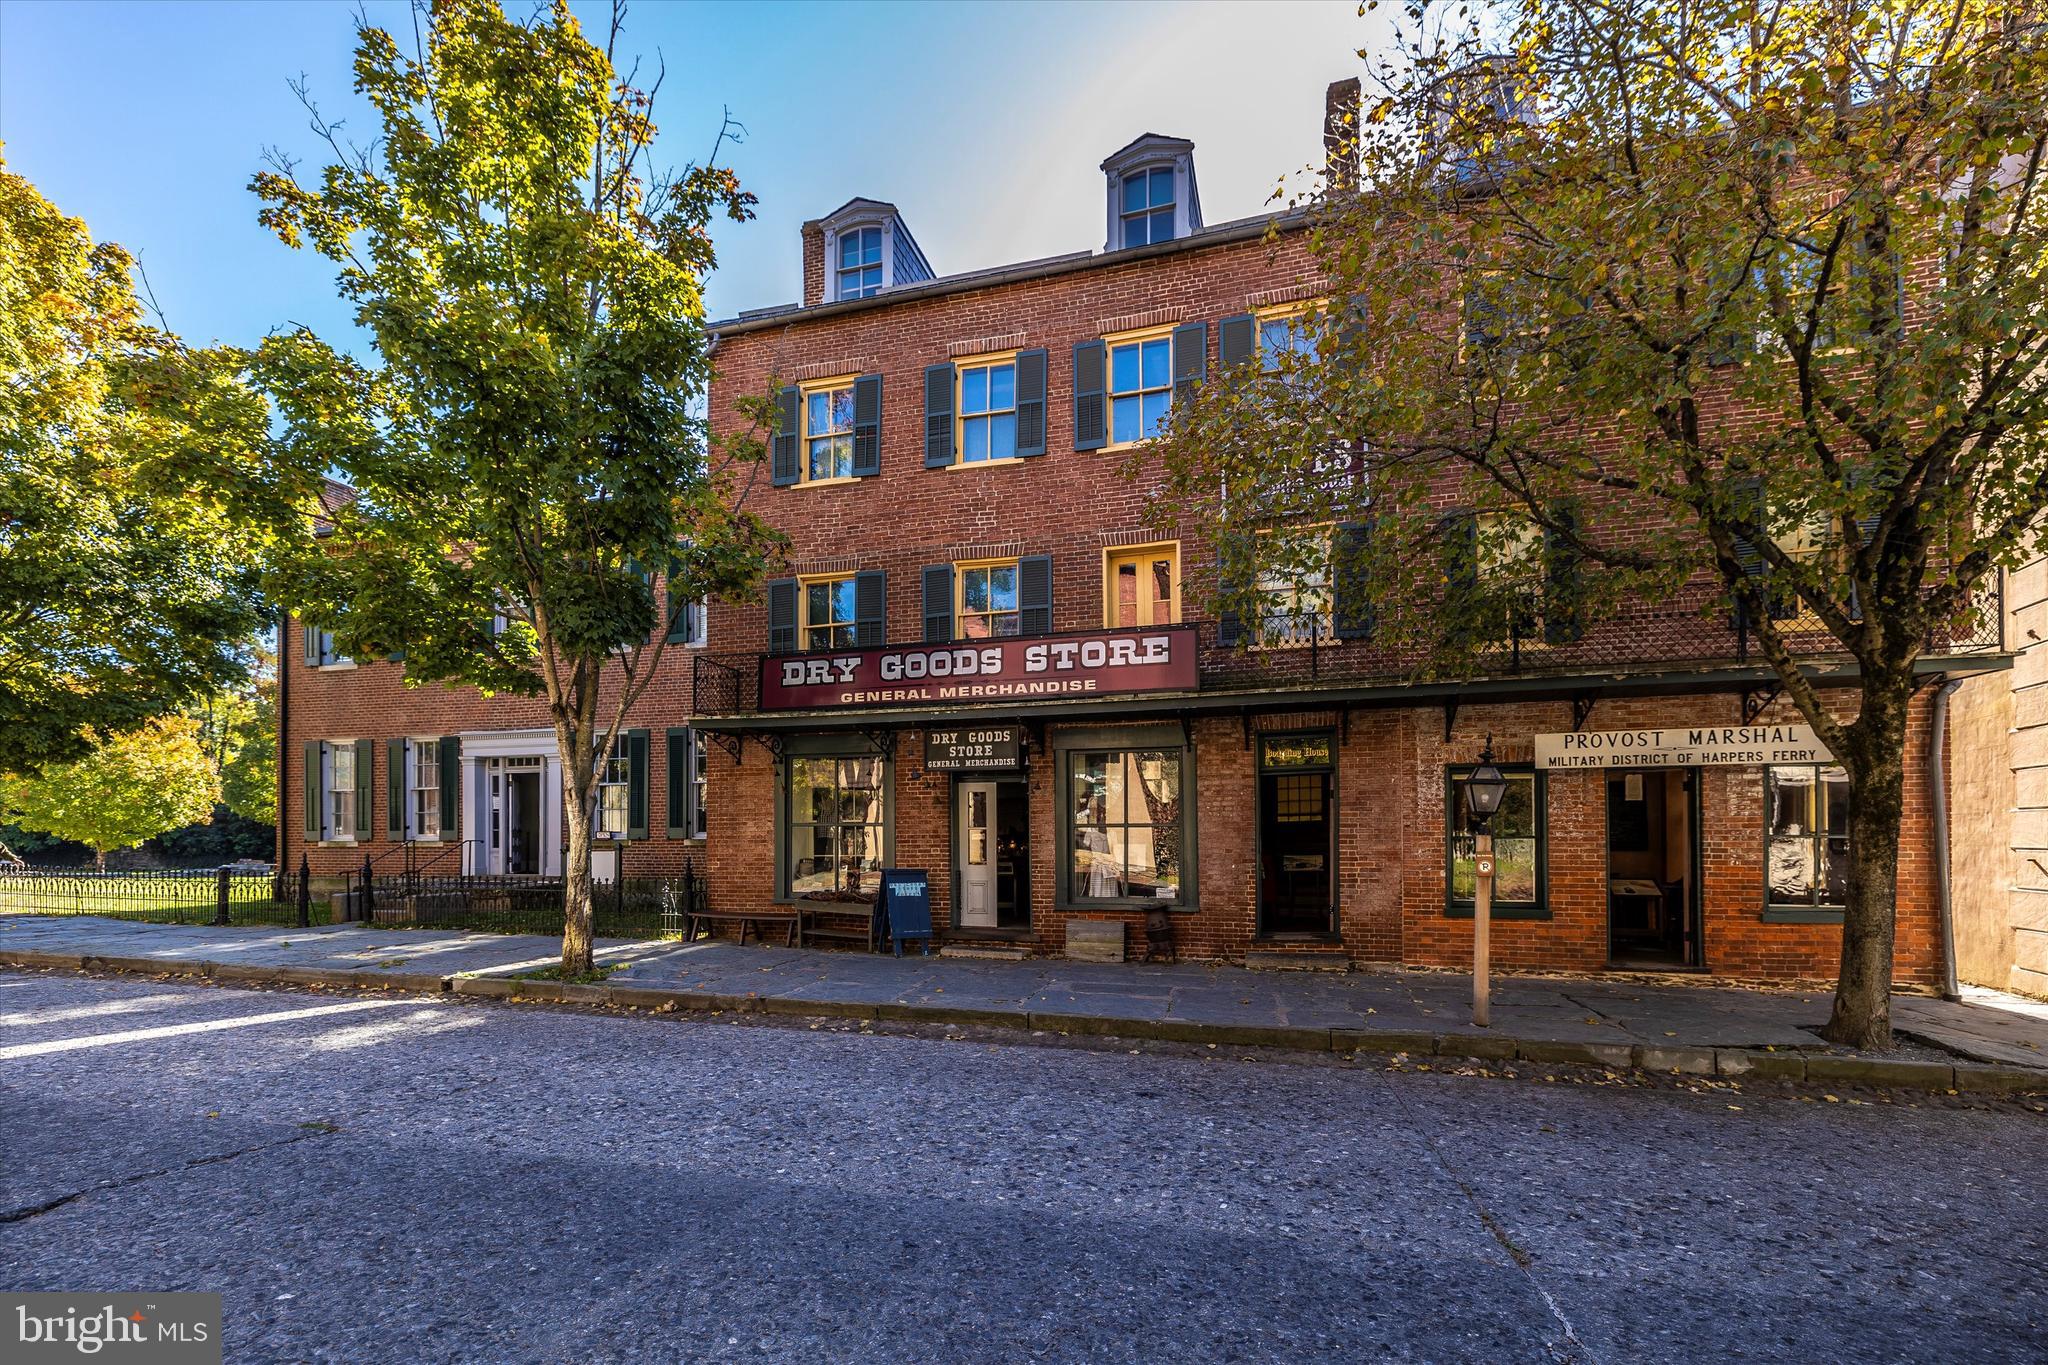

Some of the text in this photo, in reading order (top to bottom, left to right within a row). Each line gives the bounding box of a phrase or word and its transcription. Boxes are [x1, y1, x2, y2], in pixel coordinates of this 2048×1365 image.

[782, 636, 1169, 686] DRY GOODS STORE
[840, 679, 1097, 703] GENERAL MERCHANDISE
[931, 730, 1011, 745] DRY GOODS
[1564, 727, 1798, 749] PROVOST MARSHAL
[949, 745, 993, 757] STORE
[1548, 749, 1817, 767] MILITARY DISTRICT OF HARPERS FERRY
[927, 758, 1016, 768] GENERAL MERCHANDISE
